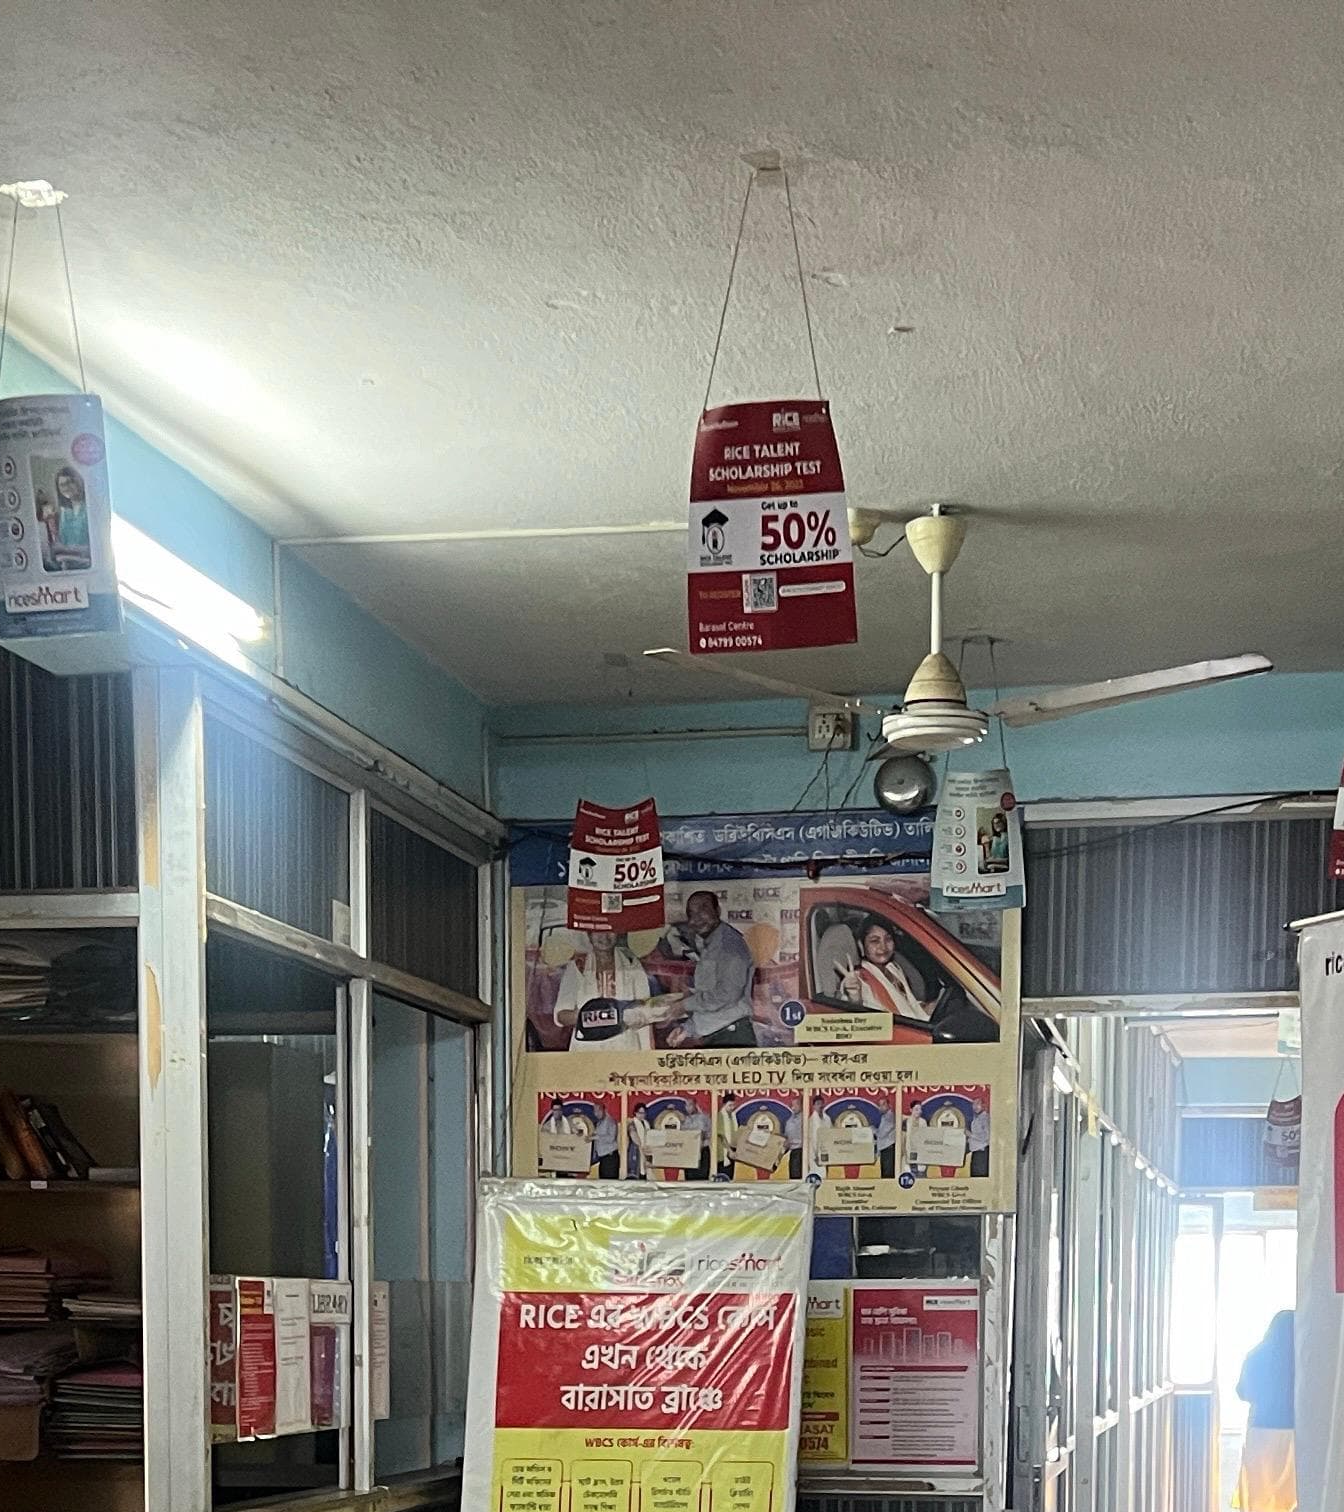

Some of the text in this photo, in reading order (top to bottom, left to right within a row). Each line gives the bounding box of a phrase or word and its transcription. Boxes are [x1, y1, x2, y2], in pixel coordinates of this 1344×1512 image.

[724, 442, 800, 461] RICE TALENT
[709, 460, 822, 482] SCHOLARSHIP TEST
[760, 510, 837, 552] 50%
[760, 550, 840, 566] SCHOLARSHIP
[614, 858, 657, 883] 50%
[732, 1071, 786, 1085] LED TV
[519, 1304, 582, 1329] RICE
[581, 1344, 639, 1370] এখন
[560, 1385, 654, 1412] বারাসাত
